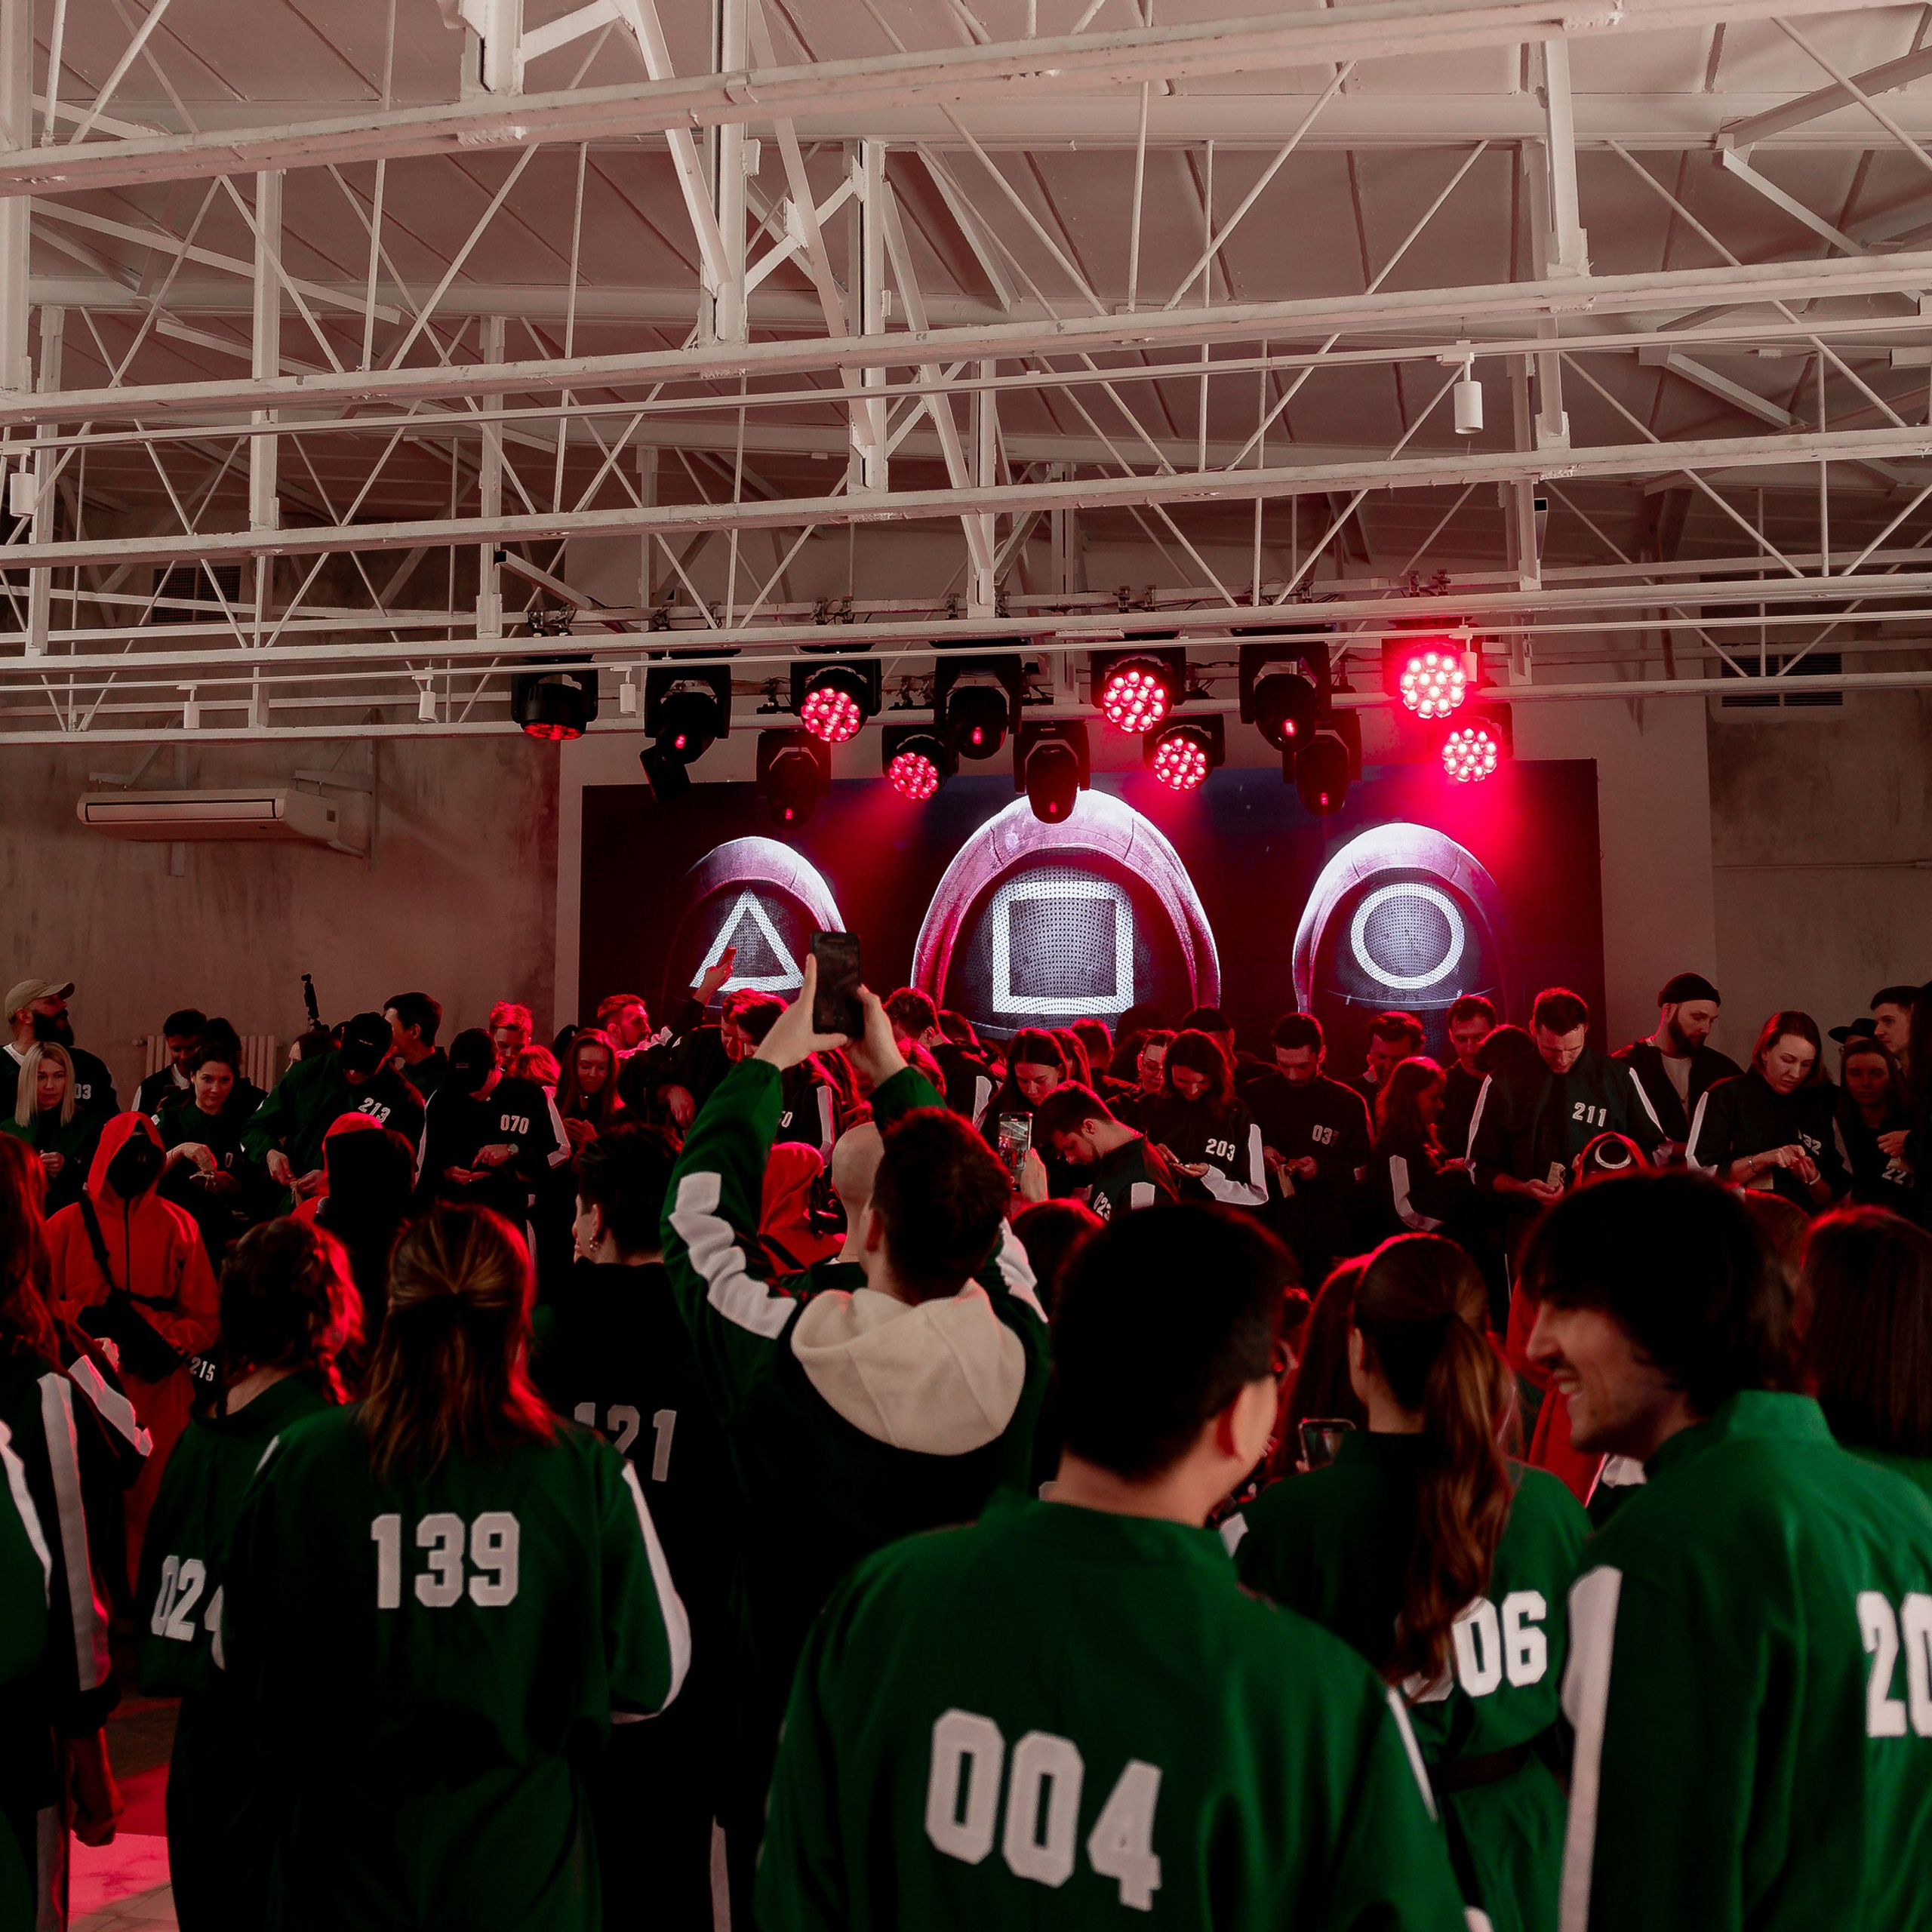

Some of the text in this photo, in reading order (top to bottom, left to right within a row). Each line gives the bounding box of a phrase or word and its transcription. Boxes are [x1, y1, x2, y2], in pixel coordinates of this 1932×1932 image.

[358, 1097, 390, 1124] 213
[1572, 1102, 1607, 1128] 211
[500, 1114, 529, 1134] 070
[1205, 1138, 1235, 1161] 203
[189, 1356, 216, 1382] 215
[370, 1511, 521, 1609] 139
[923, 1706, 1164, 1912] 004
